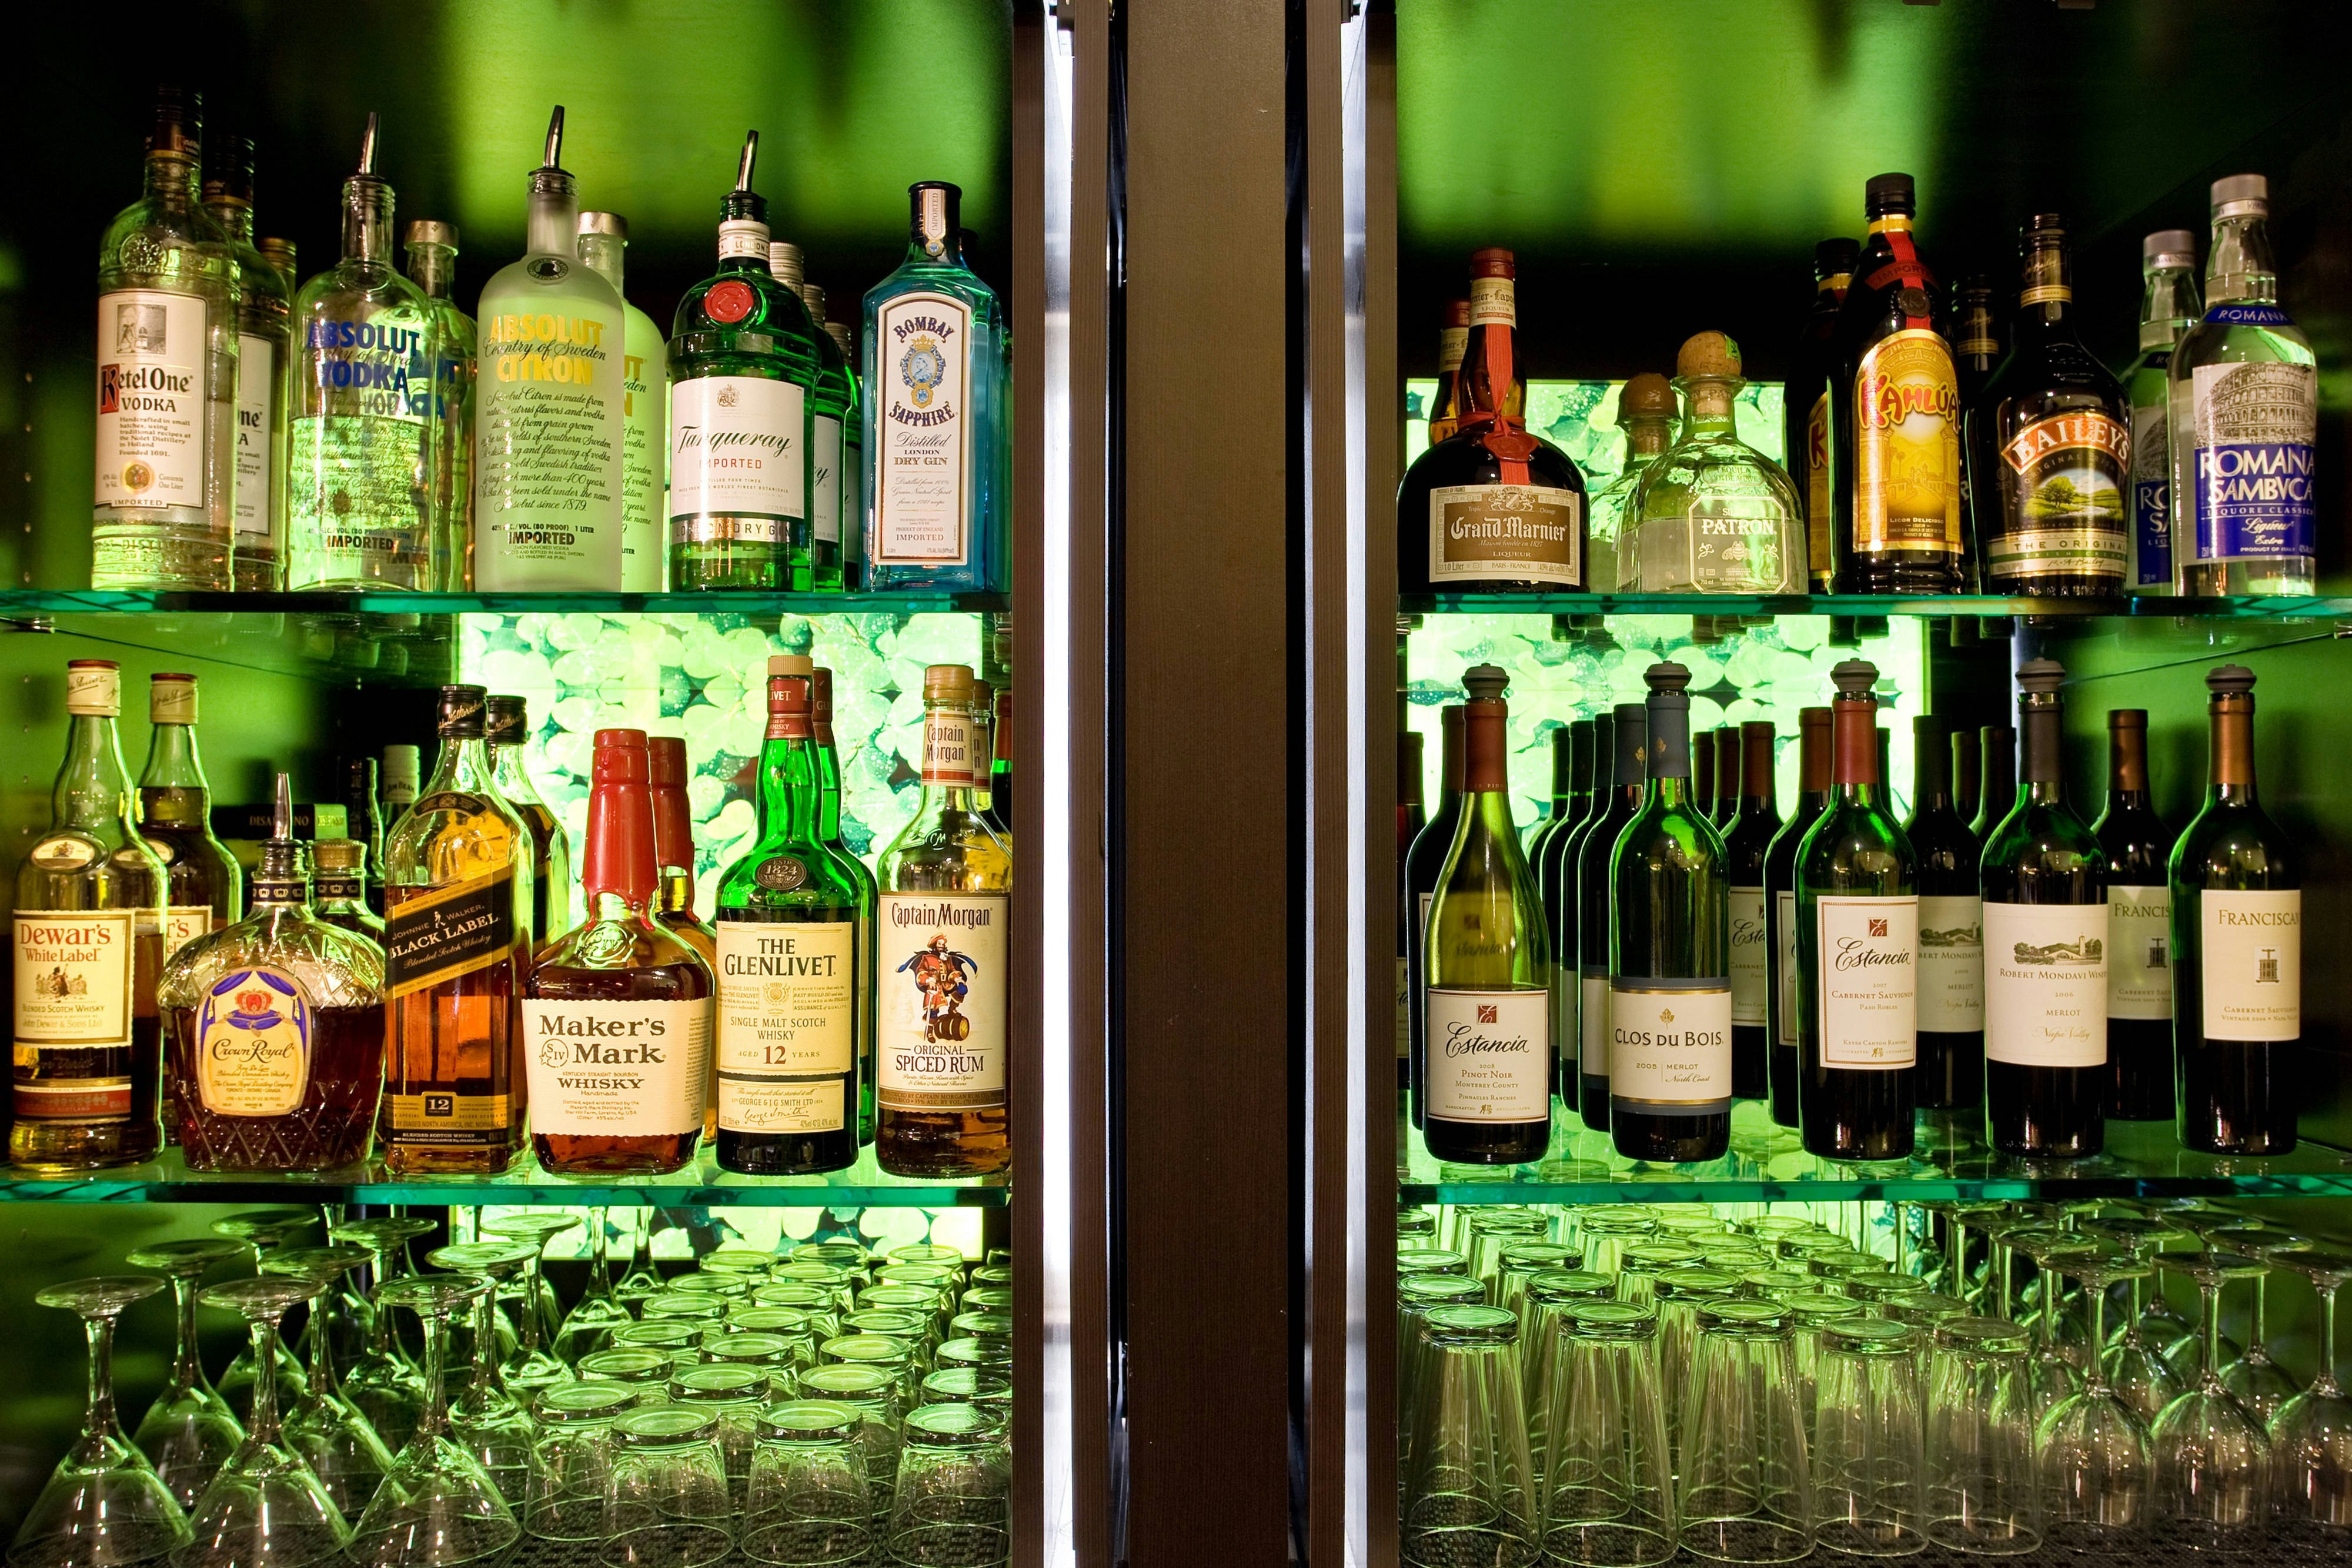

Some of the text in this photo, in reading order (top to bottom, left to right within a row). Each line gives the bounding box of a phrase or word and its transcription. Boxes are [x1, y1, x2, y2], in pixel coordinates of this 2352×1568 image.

[736, 240, 765, 252] LONDON
[2218, 310, 2288, 322] ROMANA
[490, 314, 603, 347] ABSOLUT
[893, 316, 956, 342] BOMBAY
[307, 321, 420, 356] ABSOLUT
[483, 336, 606, 362] Country of Sweden
[320, 360, 409, 394] VODKA
[496, 354, 593, 386] CITRON
[101, 366, 190, 408] Ketel One
[522, 386, 604, 407] Citron is made from
[1859, 372, 1960, 434] KAHLÚA
[121, 397, 176, 412] VODKA
[534, 404, 605, 420] flavors vodka
[888, 401, 956, 427] SAPPHIRE
[520, 417, 567, 432] from grain
[152, 436, 186, 445] Distillery
[582, 435, 612, 449] Sweden
[677, 426, 793, 457] Taqueray
[894, 431, 952, 447] Distilled
[2012, 418, 2130, 466] BAILEYS
[541, 444, 580, 461] flavoring
[530, 459, 603, 473] Swedish tradition
[699, 458, 762, 469] IPORTED
[894, 457, 948, 466] DRY GIN
[2200, 447, 2315, 479] ROMANA
[493, 500, 534, 513] Asolut
[2207, 507, 2263, 516] LQUORE
[676, 523, 791, 537] LONON DRY GIN
[1450, 516, 1566, 541] Grand Marnier
[327, 535, 395, 550] IMPORTED
[508, 531, 575, 545] IMPORTED
[2014, 540, 2127, 551] THE ORIGINAL
[927, 724, 964, 744] Captain
[386, 783, 398, 792] JIM
[249, 815, 309, 827] DISANO
[766, 865, 797, 875] 1824
[891, 902, 991, 930] Captain Morgan
[19, 924, 112, 945] Dewar's
[388, 912, 499, 960] BLACK LABEL
[392, 922, 430, 941] JOHNNIE
[403, 934, 492, 969] Blended Scotch Whisky
[757, 938, 796, 955] THE
[1835, 936, 1911, 971] Estancia
[2000, 968, 2087, 980] ROBERT MONDAVI
[1832, 990, 1914, 999] CABERNET SAUVIGNON
[22, 1003, 106, 1013] BLENDED SCOTCH WHISKY
[539, 1014, 666, 1037] Maker's
[730, 1016, 826, 1028] SINGLE MALT SCOTCH
[757, 1029, 795, 1040] WHISKY
[1445, 1021, 1530, 1059] Estancia
[1615, 1028, 1722, 1047] CLOS DU BOIS
[212, 1038, 291, 1064] Crown Royal
[546, 1044, 554, 1053] S
[554, 1051, 566, 1060] IV
[572, 1043, 665, 1064] Mark
[763, 1045, 787, 1065] 12
[914, 1045, 965, 1055] ORIGINAL
[896, 1055, 984, 1075] SPICED RUM
[1461, 1069, 1513, 1078] PINOT NOIR
[1665, 1073, 1692, 1083] North
[557, 1078, 645, 1089] WHISKY
[1455, 1080, 1491, 1088] MONTEREY
[428, 1098, 450, 1110] 12
[739, 1097, 801, 1106] GEORGE SMITH
